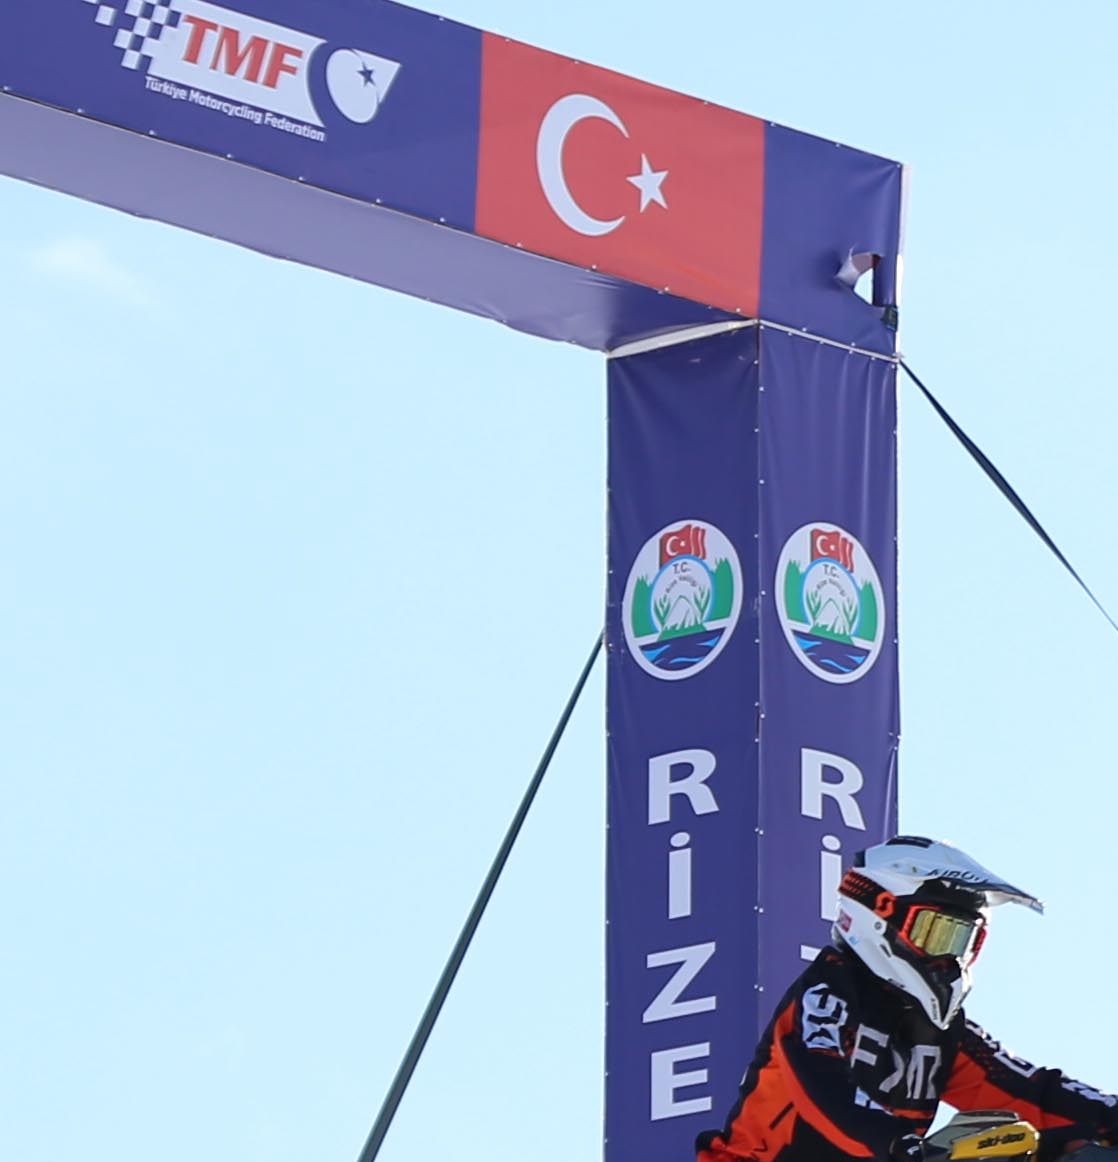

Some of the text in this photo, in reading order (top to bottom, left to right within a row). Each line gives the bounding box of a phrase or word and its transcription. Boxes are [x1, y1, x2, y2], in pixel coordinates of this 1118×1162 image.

[183, 15, 303, 88] TMF
[145, 76, 325, 142] Türkiye Motorcycling Federation
